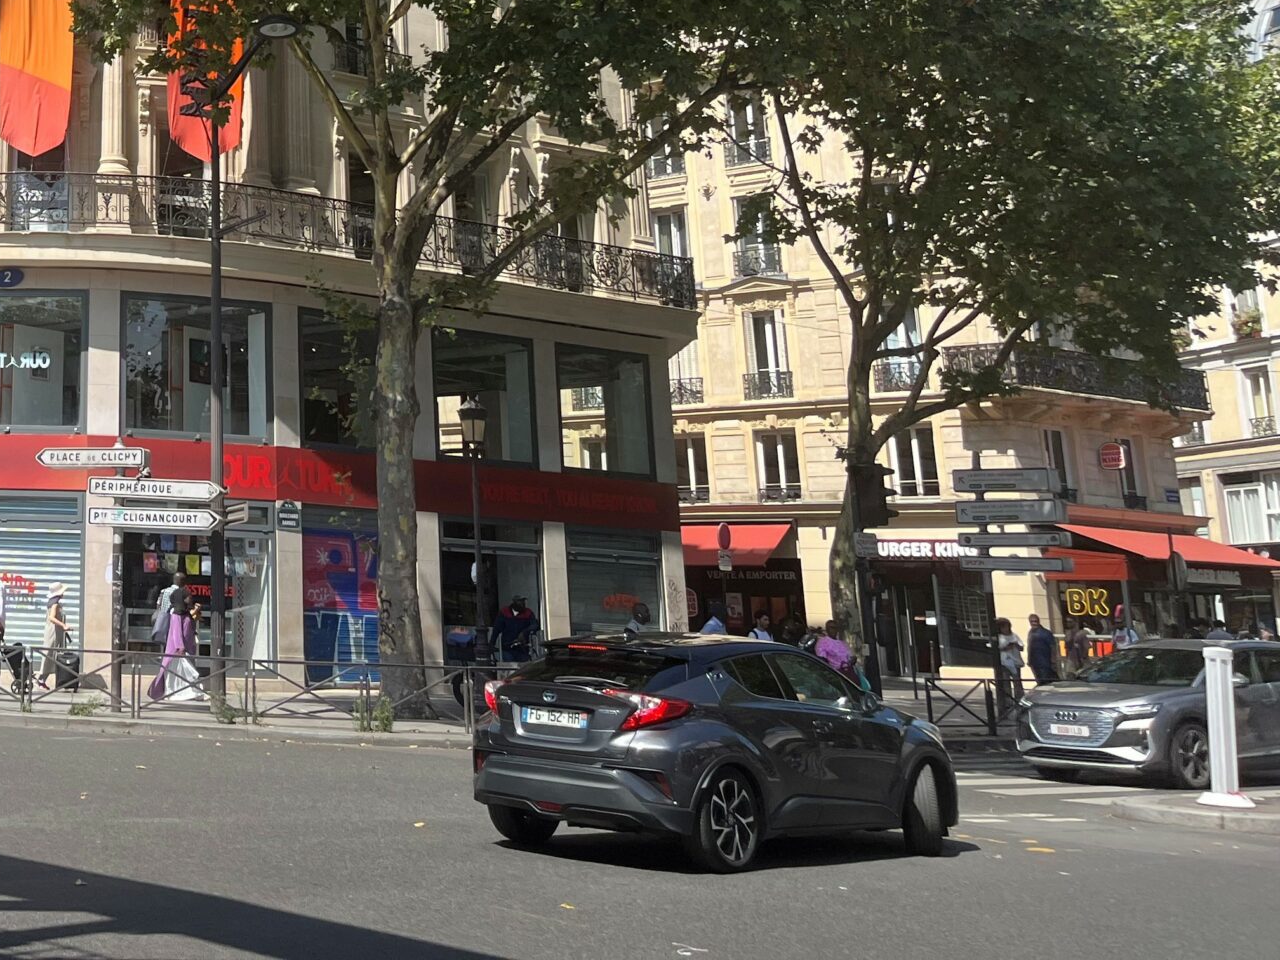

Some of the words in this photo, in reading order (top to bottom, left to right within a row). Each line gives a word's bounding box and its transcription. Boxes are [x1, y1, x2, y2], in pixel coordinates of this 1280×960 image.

[3, 271, 12, 283] 2
[49, 452, 81, 462] PLACE
[101, 452, 138, 462] CLICHY
[94, 480, 172, 494] PÉRIPHÉRIQUE
[123, 513, 198, 524] CLIGNANCOURT
[877, 541, 932, 557] URGER
[706, 570, 738, 580] VETE
[746, 570, 797, 581] EMPORTER
[1066, 588, 1110, 617] BK
